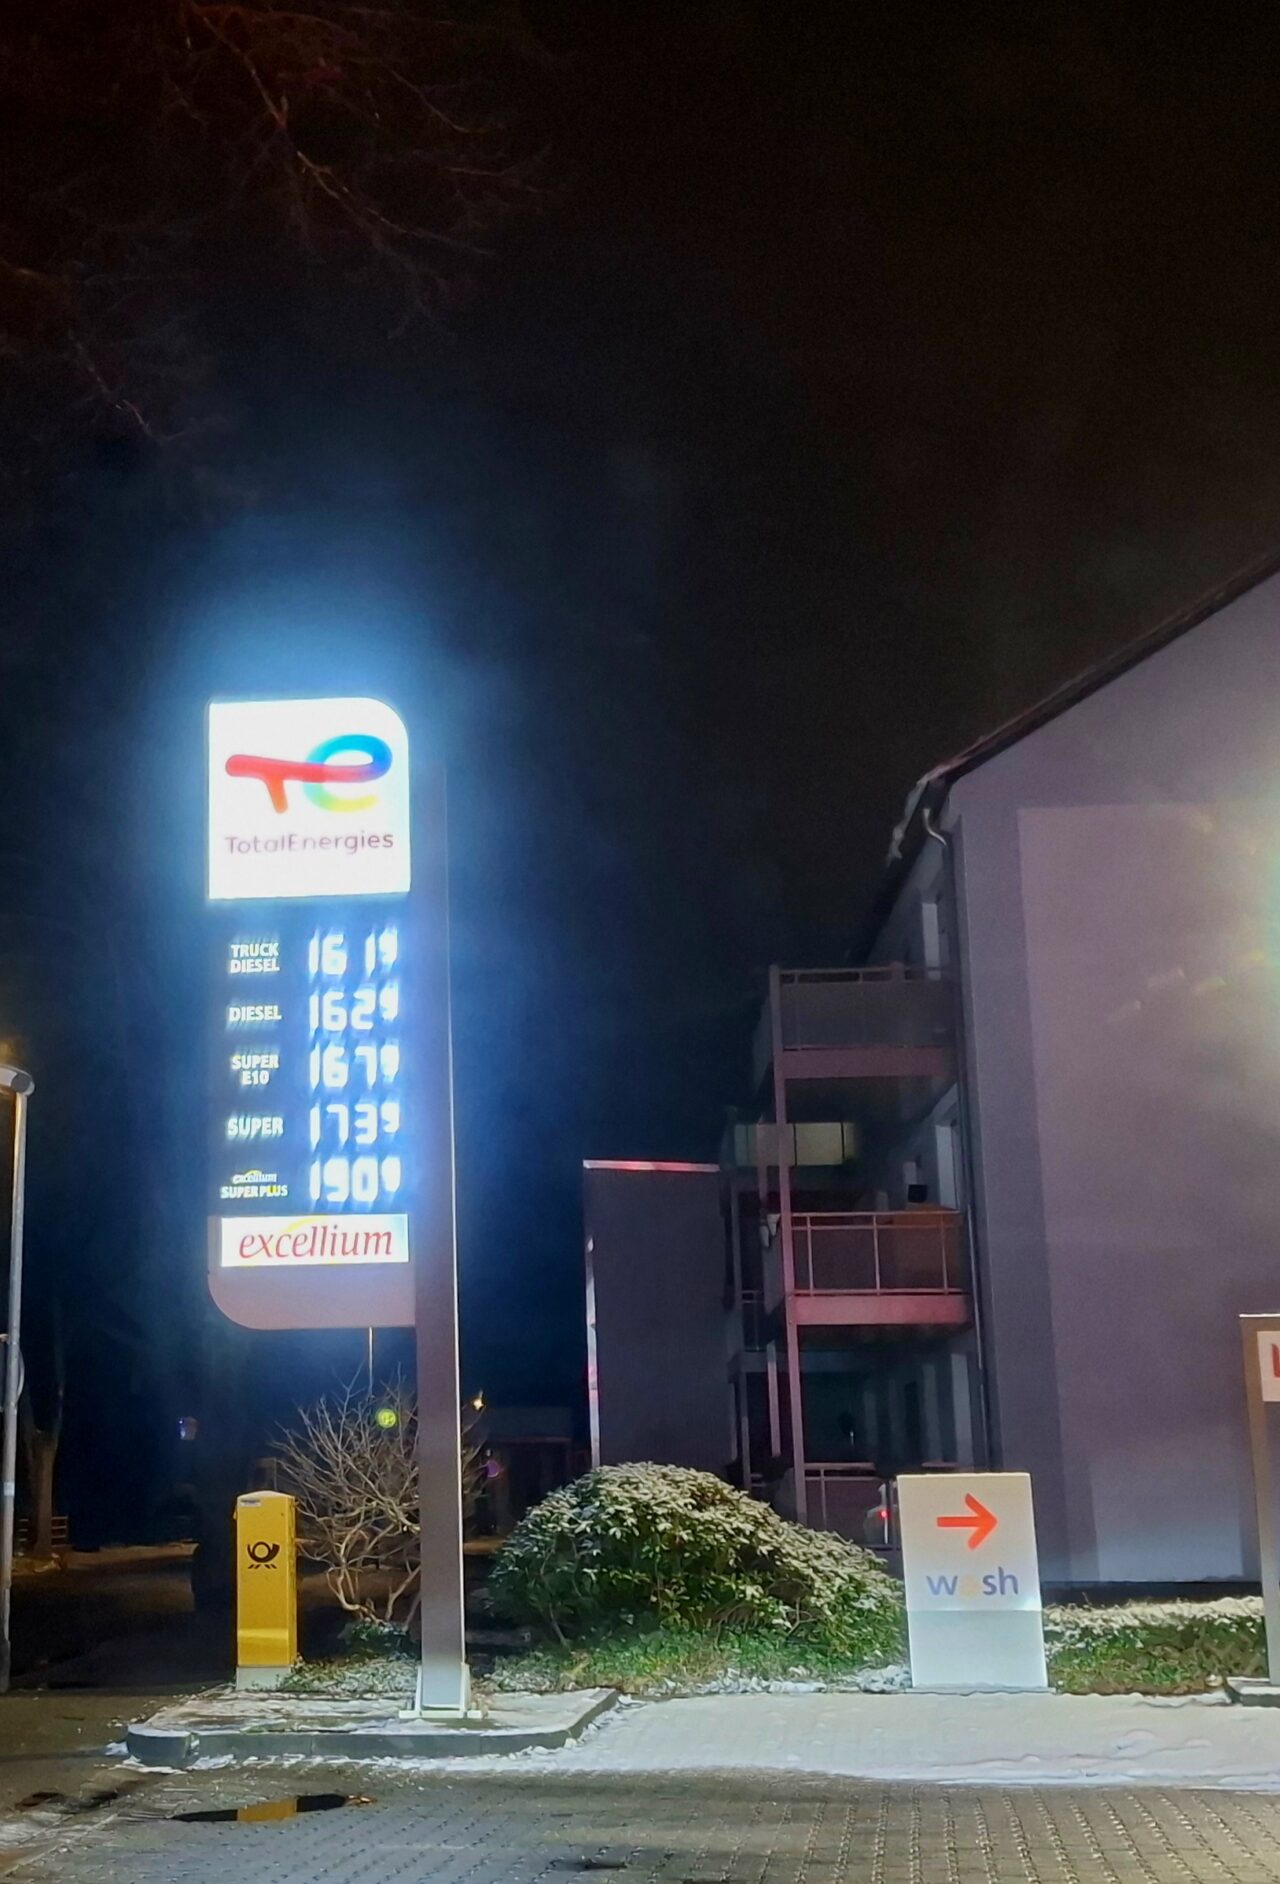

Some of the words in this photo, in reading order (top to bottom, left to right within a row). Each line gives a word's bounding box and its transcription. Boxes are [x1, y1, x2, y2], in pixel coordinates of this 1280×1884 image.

[224, 830, 394, 855] TotalEnergies
[231, 942, 279, 958] TRUCK
[230, 957, 280, 974] DIESEL
[228, 1005, 282, 1022] DIESEL
[231, 1055, 279, 1070] SUPER
[241, 1070, 270, 1086] E10
[227, 1116, 284, 1137] SUPER
[220, 1185, 258, 1199] SUPER
[259, 1184, 289, 1198] PLUS
[239, 1225, 393, 1260] excellium
